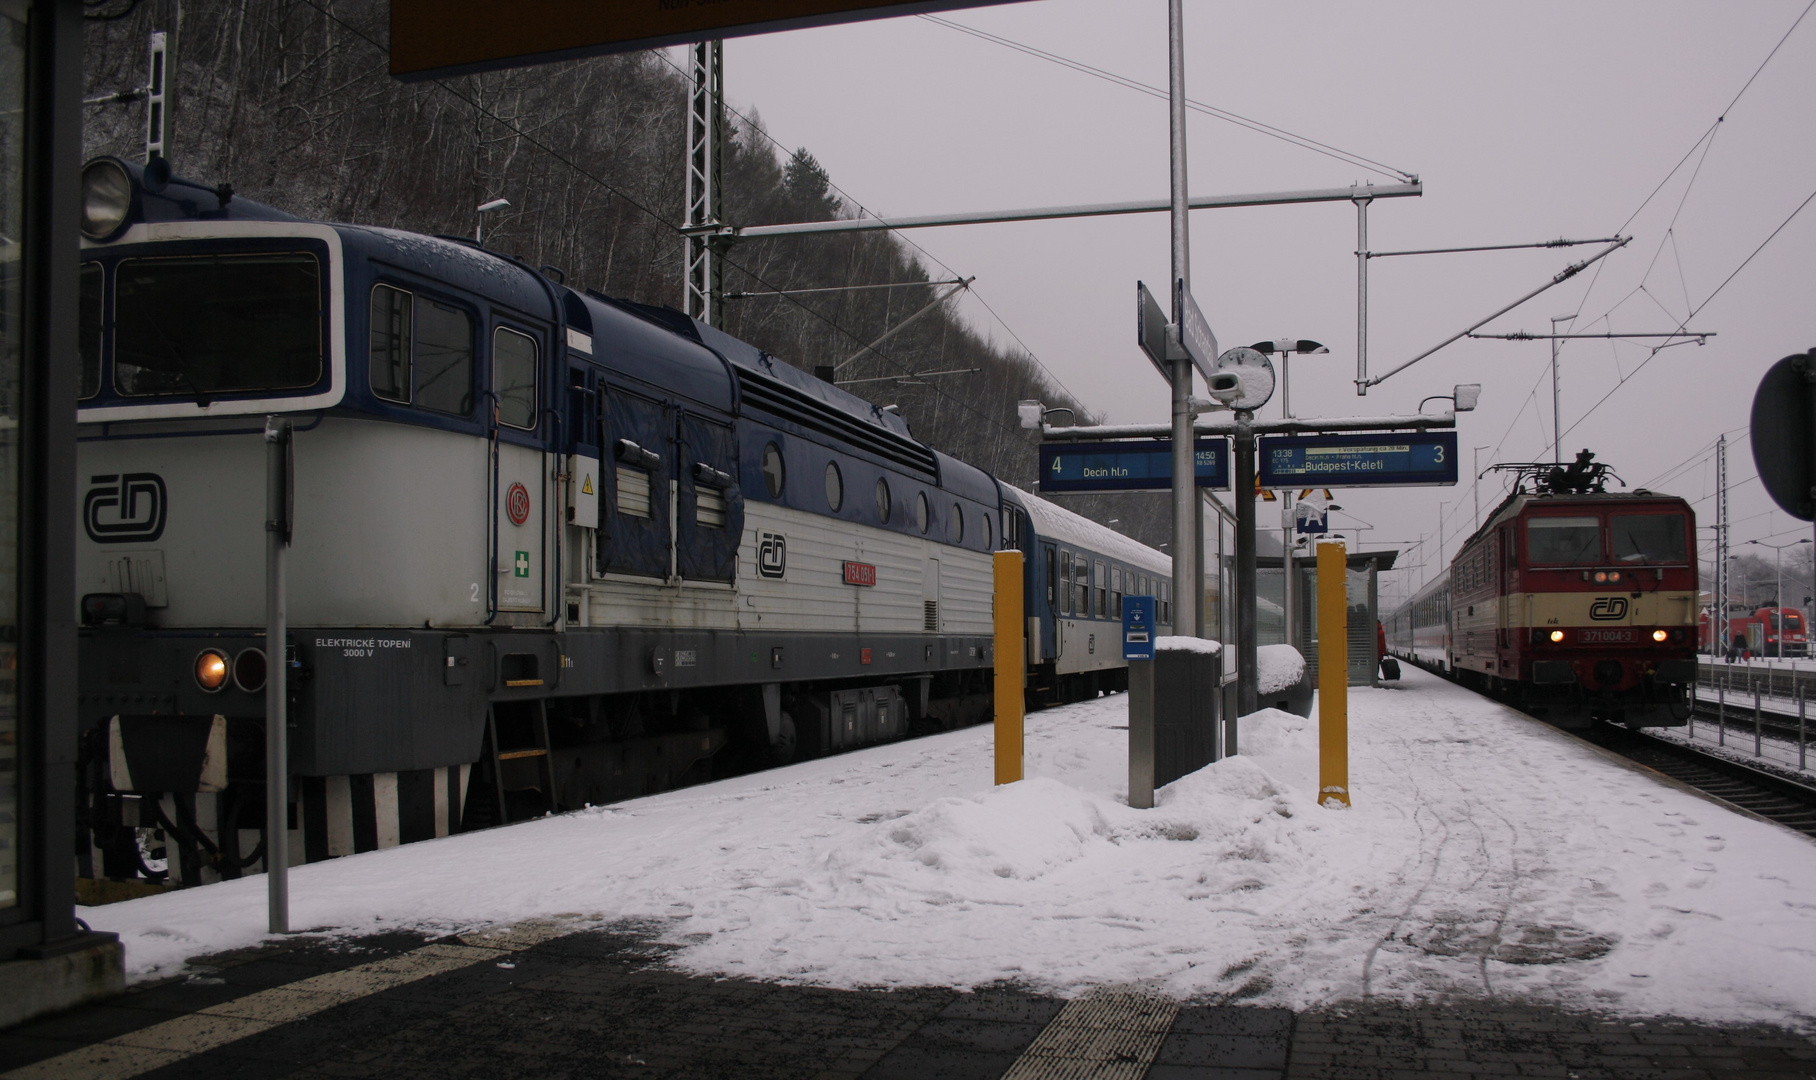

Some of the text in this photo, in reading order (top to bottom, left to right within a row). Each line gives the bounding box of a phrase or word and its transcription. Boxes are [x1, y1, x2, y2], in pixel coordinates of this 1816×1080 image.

[1195, 451, 1216, 460] 14:50
[1272, 449, 1293, 458] 13:38
[1433, 445, 1445, 463] 3
[1052, 456, 1062, 473] 4
[1305, 459, 1383, 473] Budapest-Keleti
[1083, 467, 1128, 477] Decin hl.n
[847, 564, 875, 583] 754 051-1
[470, 582, 479, 602] 2
[315, 637, 412, 648] ELEKTRICKÉ TOPENÍ
[343, 649, 374, 657] 3000 V
